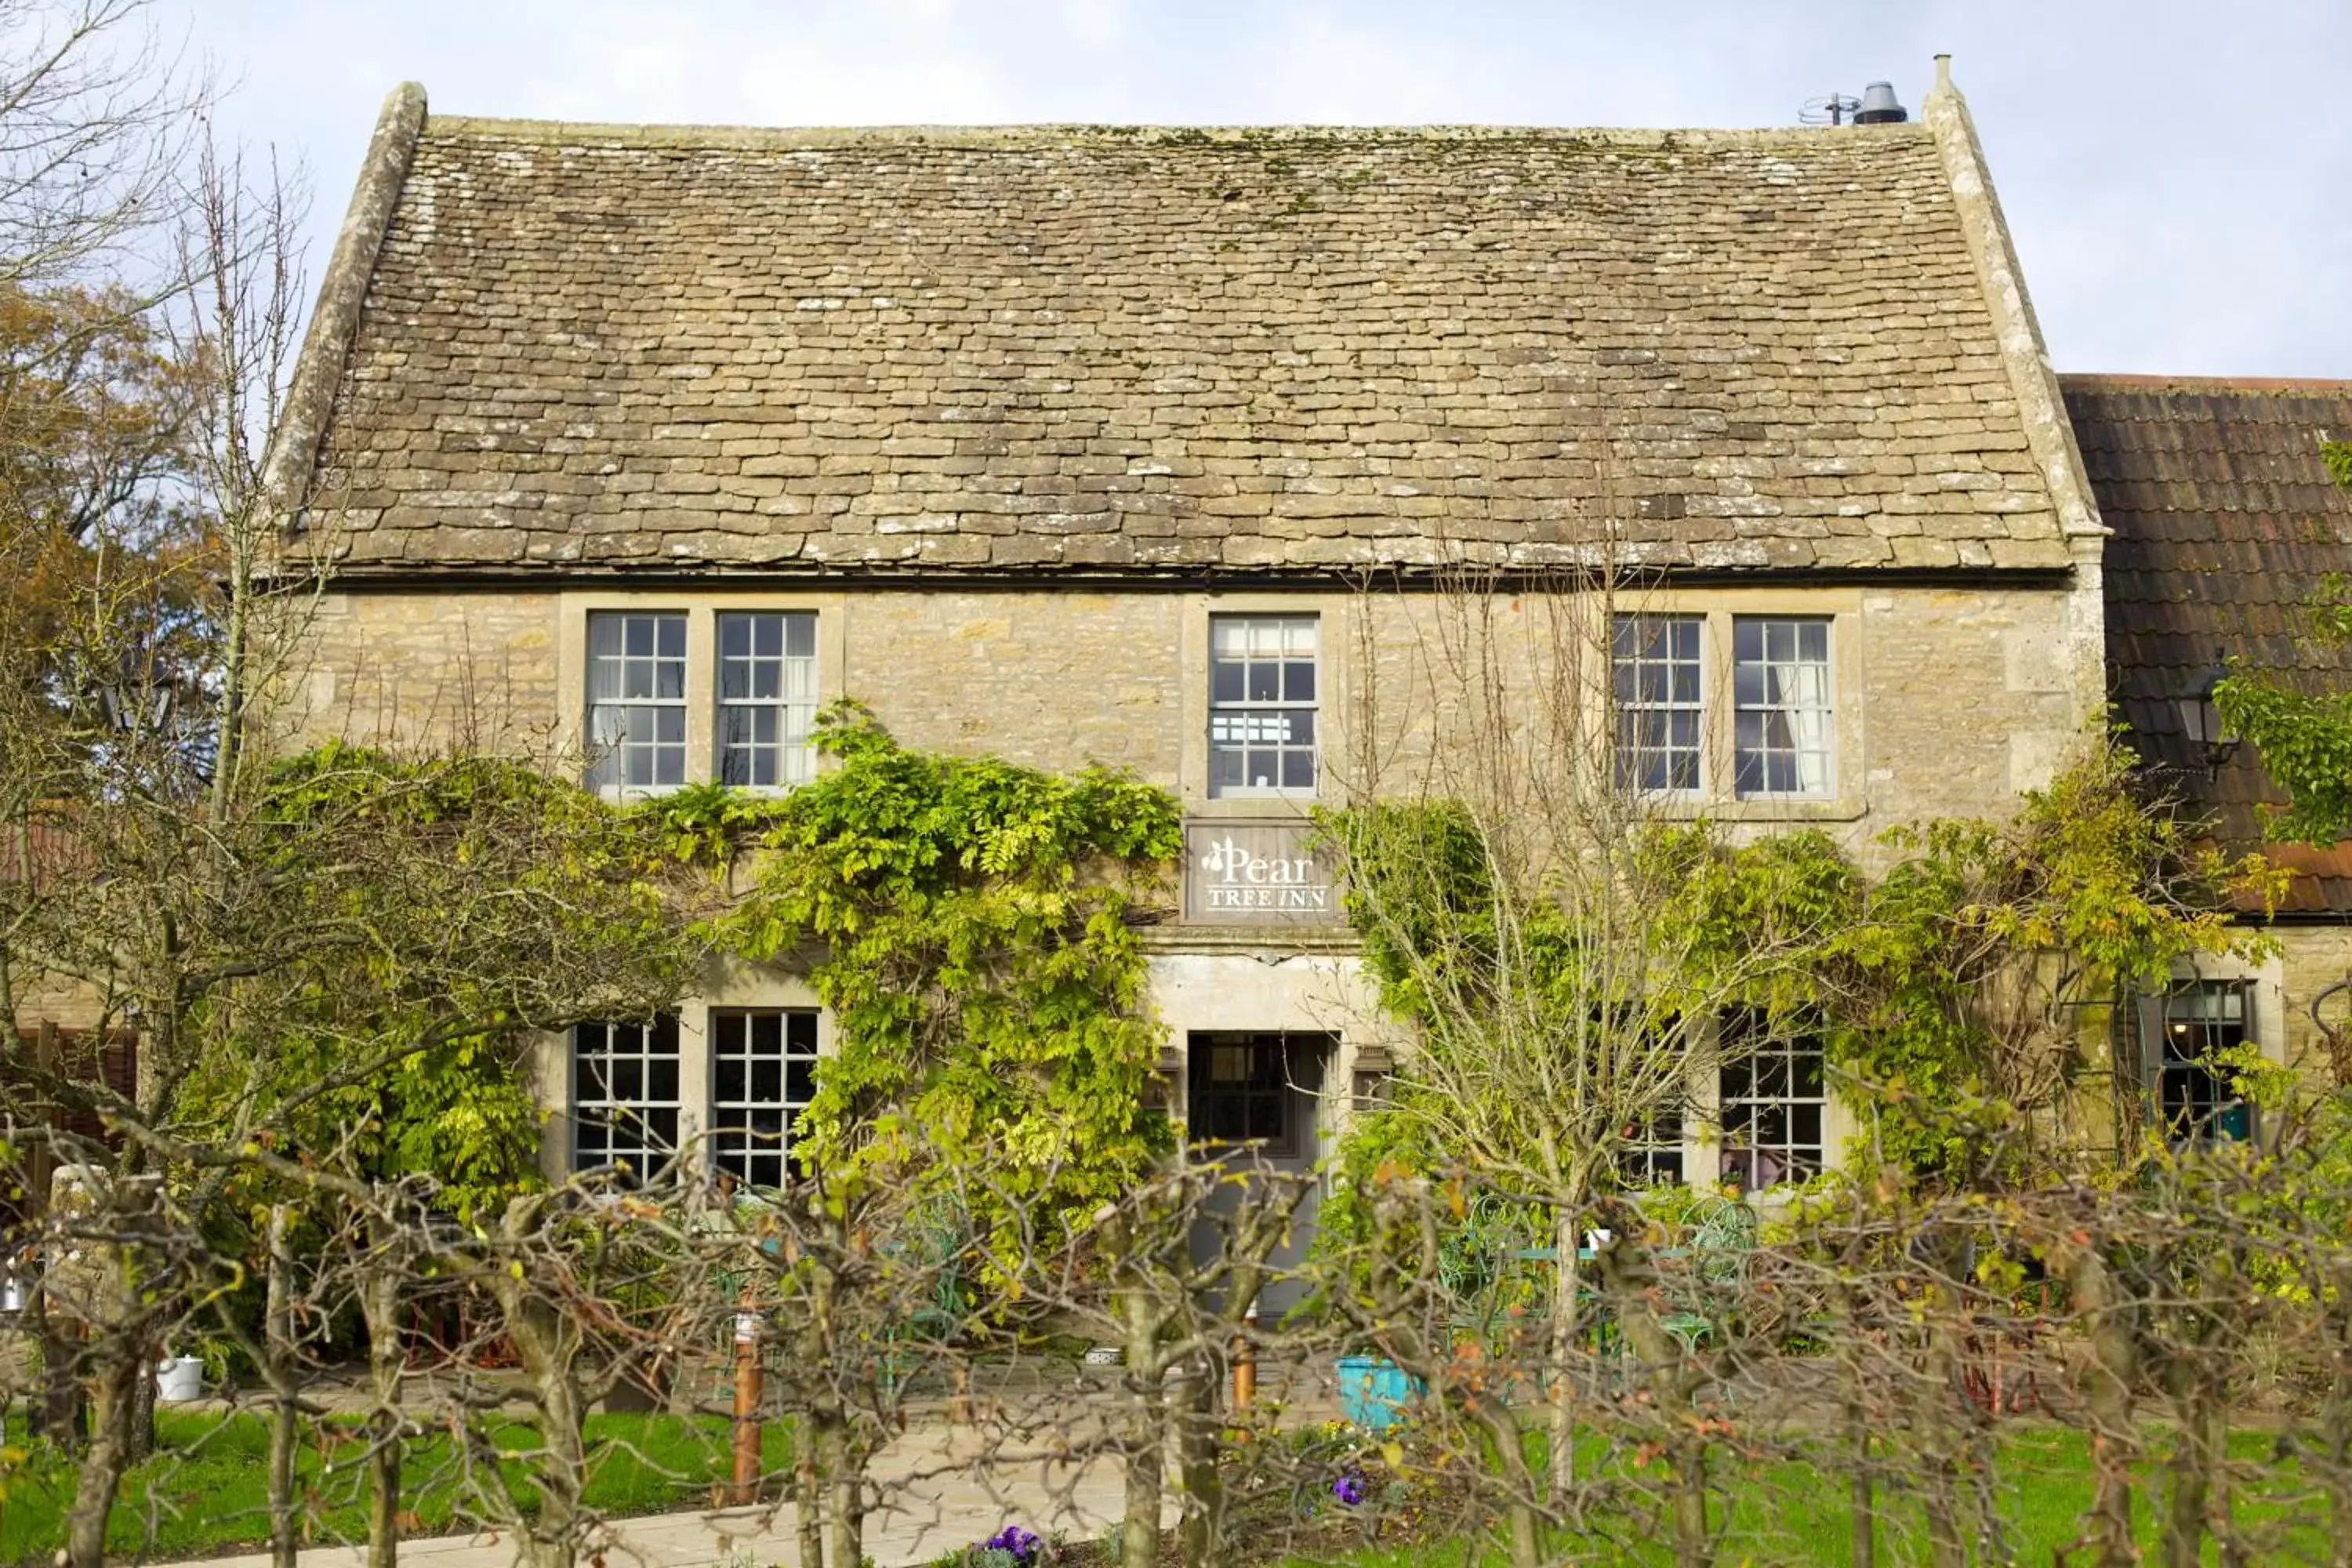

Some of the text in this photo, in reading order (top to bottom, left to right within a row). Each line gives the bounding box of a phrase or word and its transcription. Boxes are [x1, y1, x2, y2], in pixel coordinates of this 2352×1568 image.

[1221, 835, 1312, 884] Pear
[1209, 889, 1327, 906] TREE INN
